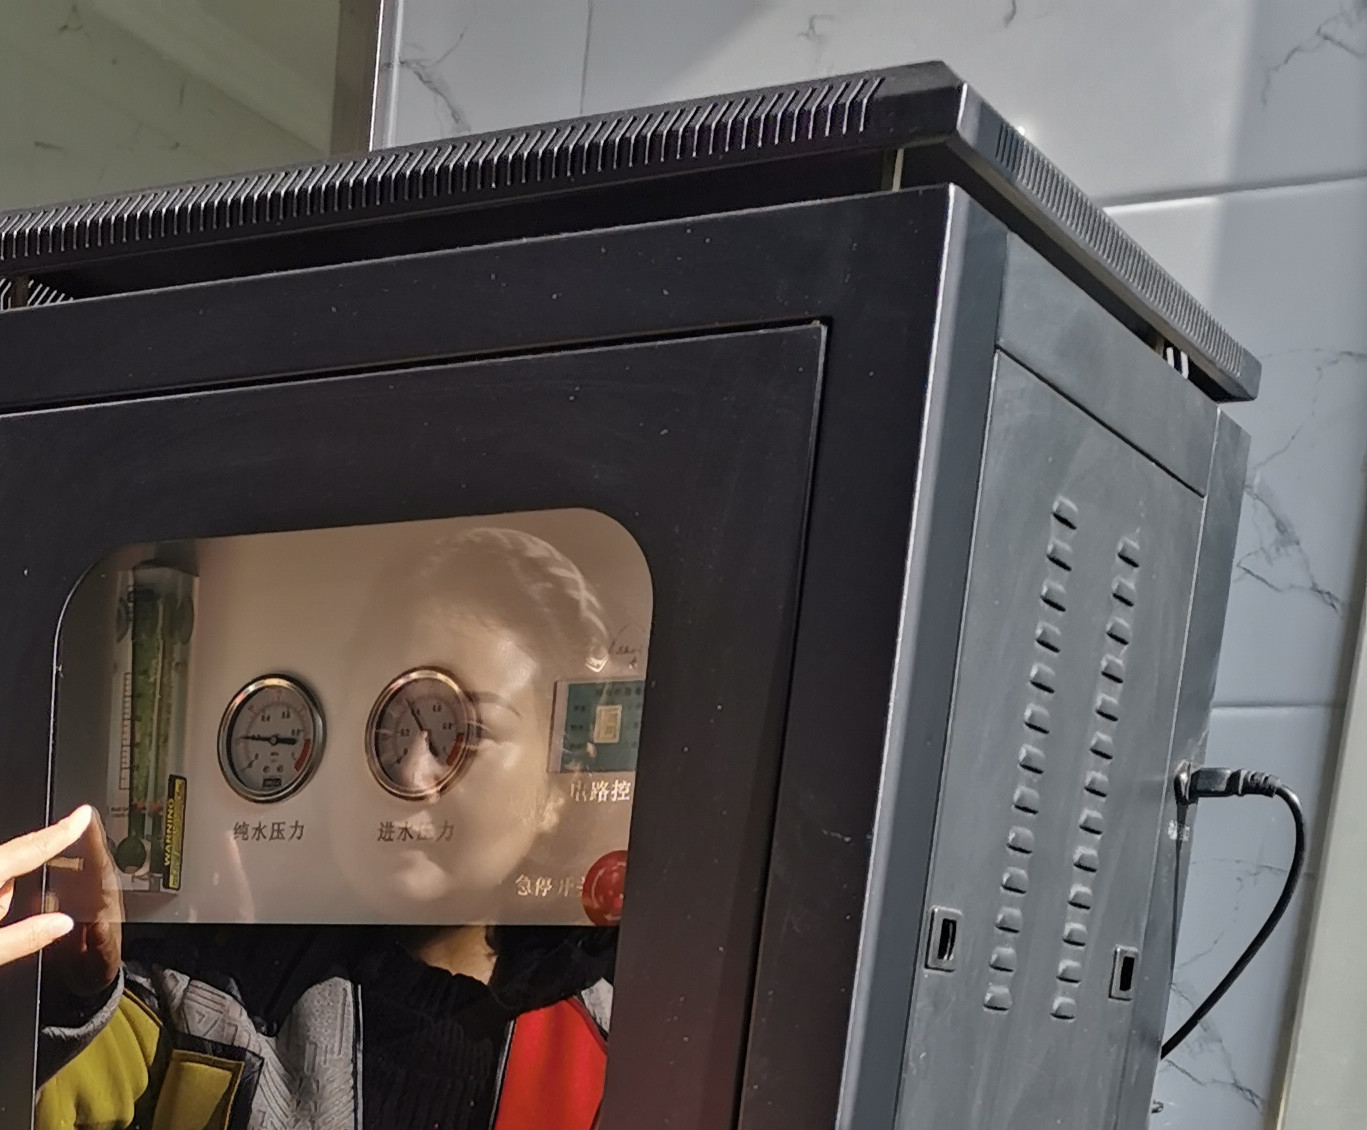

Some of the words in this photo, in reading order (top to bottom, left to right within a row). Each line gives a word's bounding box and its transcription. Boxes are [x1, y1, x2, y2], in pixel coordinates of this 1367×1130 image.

[164, 798, 175, 867] WARNING
[233, 819, 305, 842] 纯水压力
